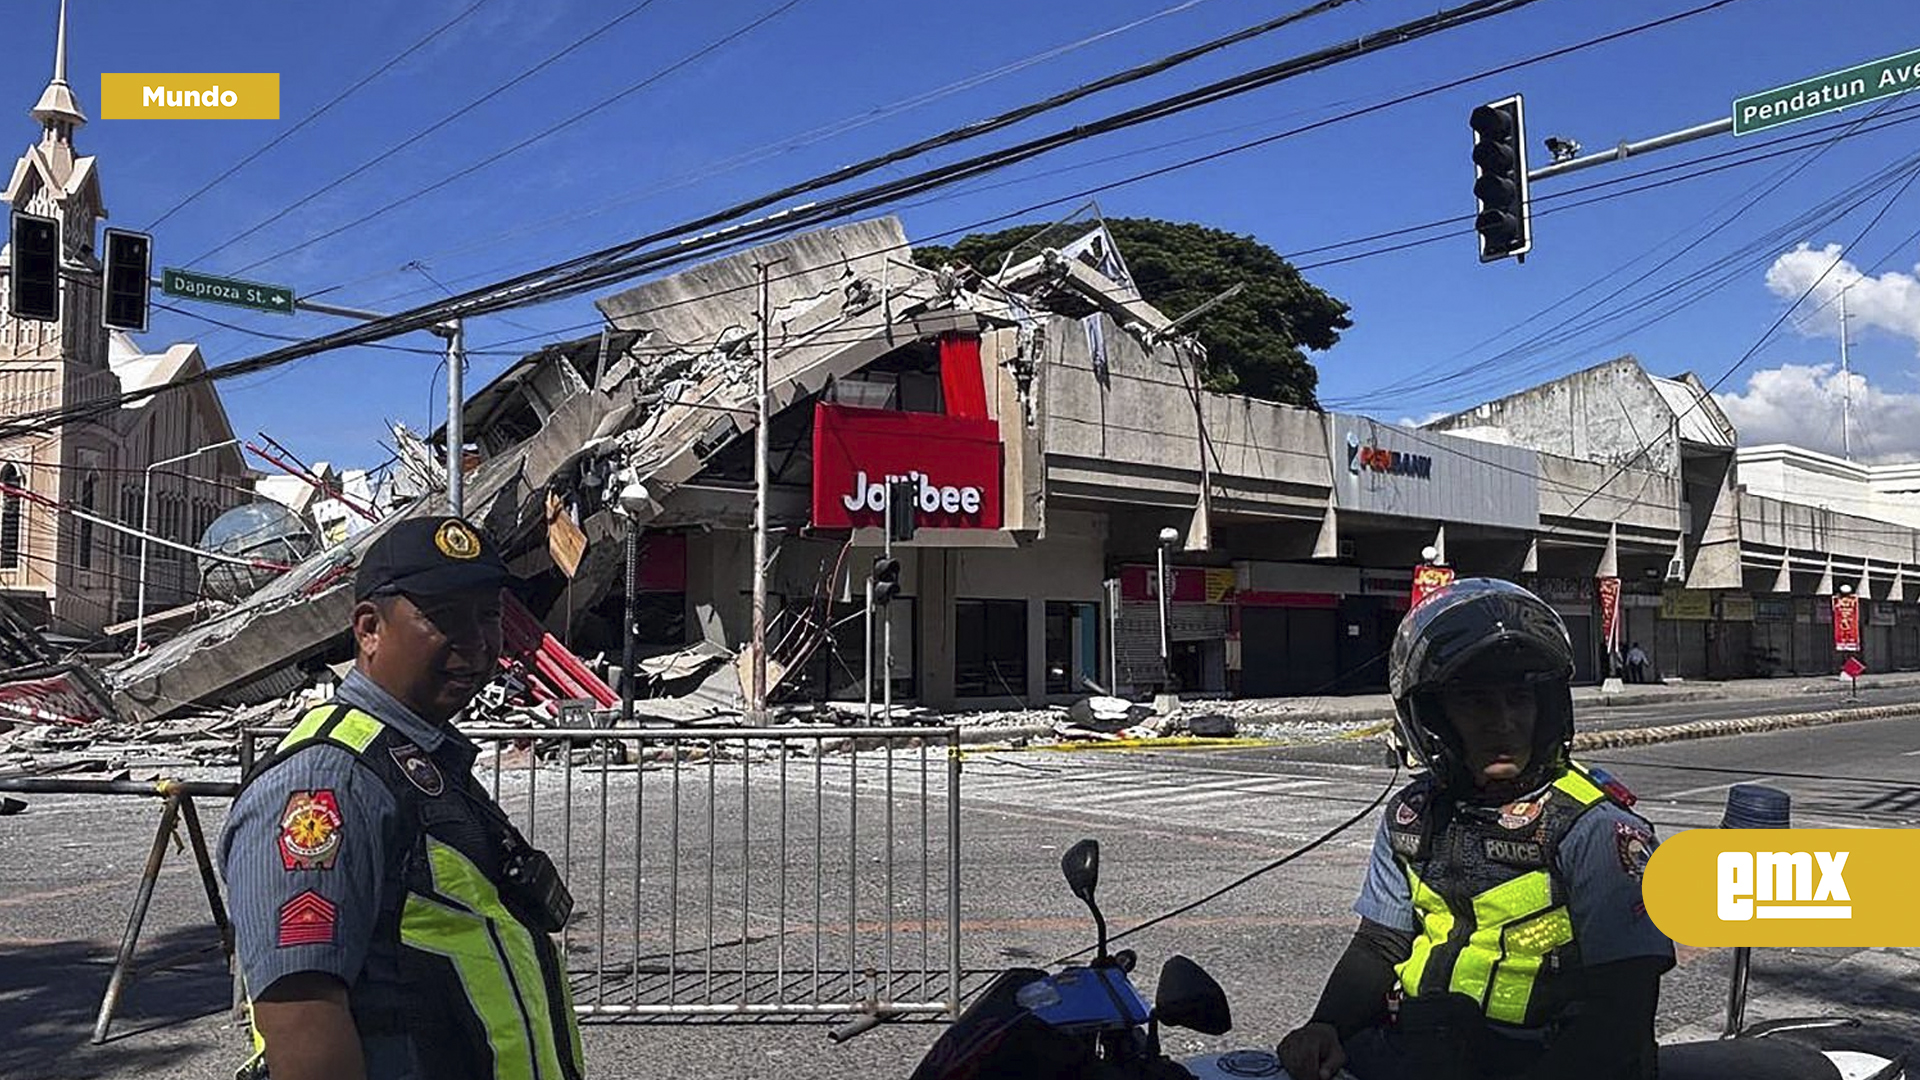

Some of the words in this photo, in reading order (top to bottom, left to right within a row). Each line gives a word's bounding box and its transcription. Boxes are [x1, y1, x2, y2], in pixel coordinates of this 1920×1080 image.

[1744, 78, 1865, 124] Pendatun
[174, 277, 240, 299] Daproza
[246, 289, 266, 304] St.
[1486, 841, 1541, 863] POLICE
